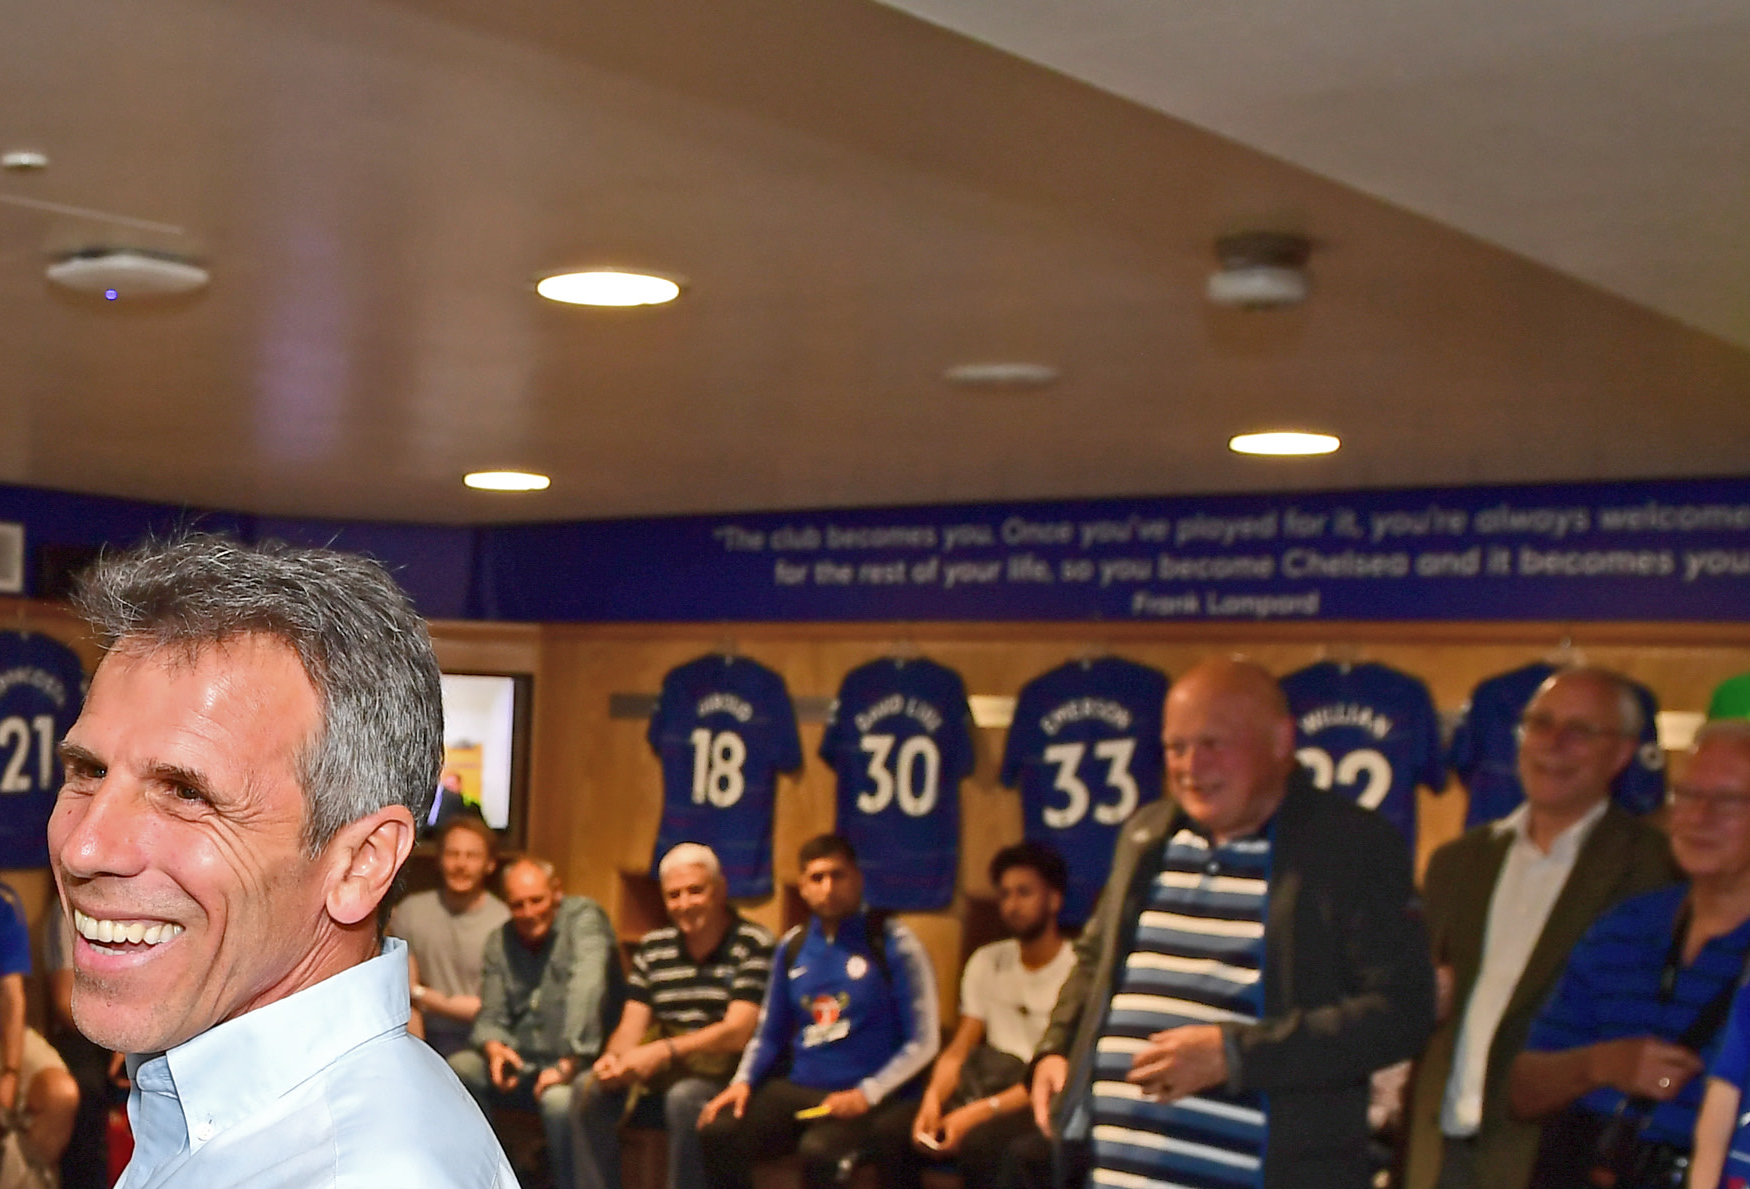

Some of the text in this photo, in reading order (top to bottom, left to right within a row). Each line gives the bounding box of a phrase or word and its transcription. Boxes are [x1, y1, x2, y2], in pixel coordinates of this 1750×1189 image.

[769, 523, 821, 550] club
[825, 523, 938, 549] becomes
[1000, 517, 1073, 546] Once
[1176, 513, 1278, 547] played
[1283, 511, 1327, 538] for
[1473, 502, 1591, 540] always
[774, 557, 808, 585] for
[813, 558, 853, 585] the
[857, 559, 906, 584] rest
[910, 556, 939, 582] of
[941, 560, 1002, 588] your
[1059, 558, 1094, 581] so
[1098, 557, 1153, 588] you
[1157, 550, 1275, 580] become
[1281, 547, 1409, 578] Chelsea
[1413, 547, 1481, 577] and
[1484, 546, 1512, 577] it
[1517, 546, 1674, 577] becomes
[1131, 588, 1320, 618] Frank Lampard
[1297, 702, 1391, 739] WILLIAN
[690, 727, 747, 808] 18
[856, 734, 941, 818] 30
[1042, 738, 1138, 829] 33
